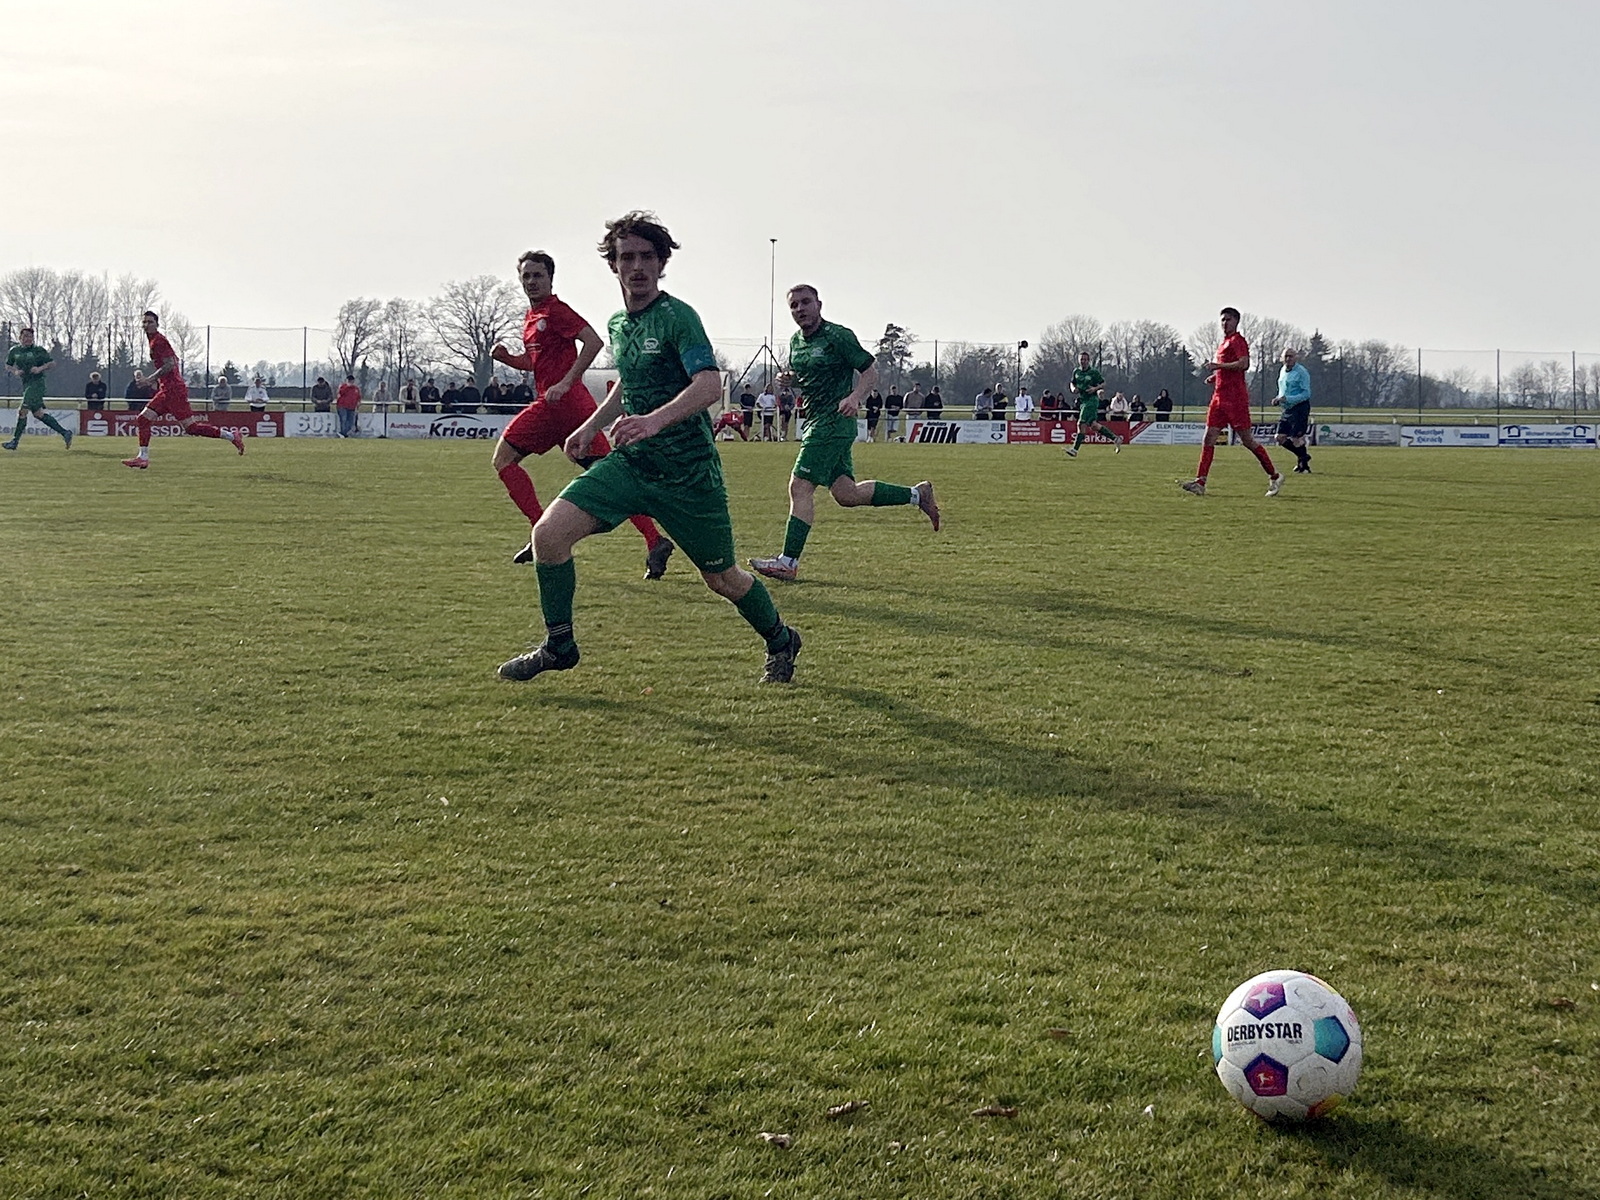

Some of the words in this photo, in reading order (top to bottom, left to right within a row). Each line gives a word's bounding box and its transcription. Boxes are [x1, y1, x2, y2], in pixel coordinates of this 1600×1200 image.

[390, 422, 426, 430] Autohaus
[429, 421, 498, 438] Krieger
[1227, 1023, 1303, 1042] DERBYSTAR
